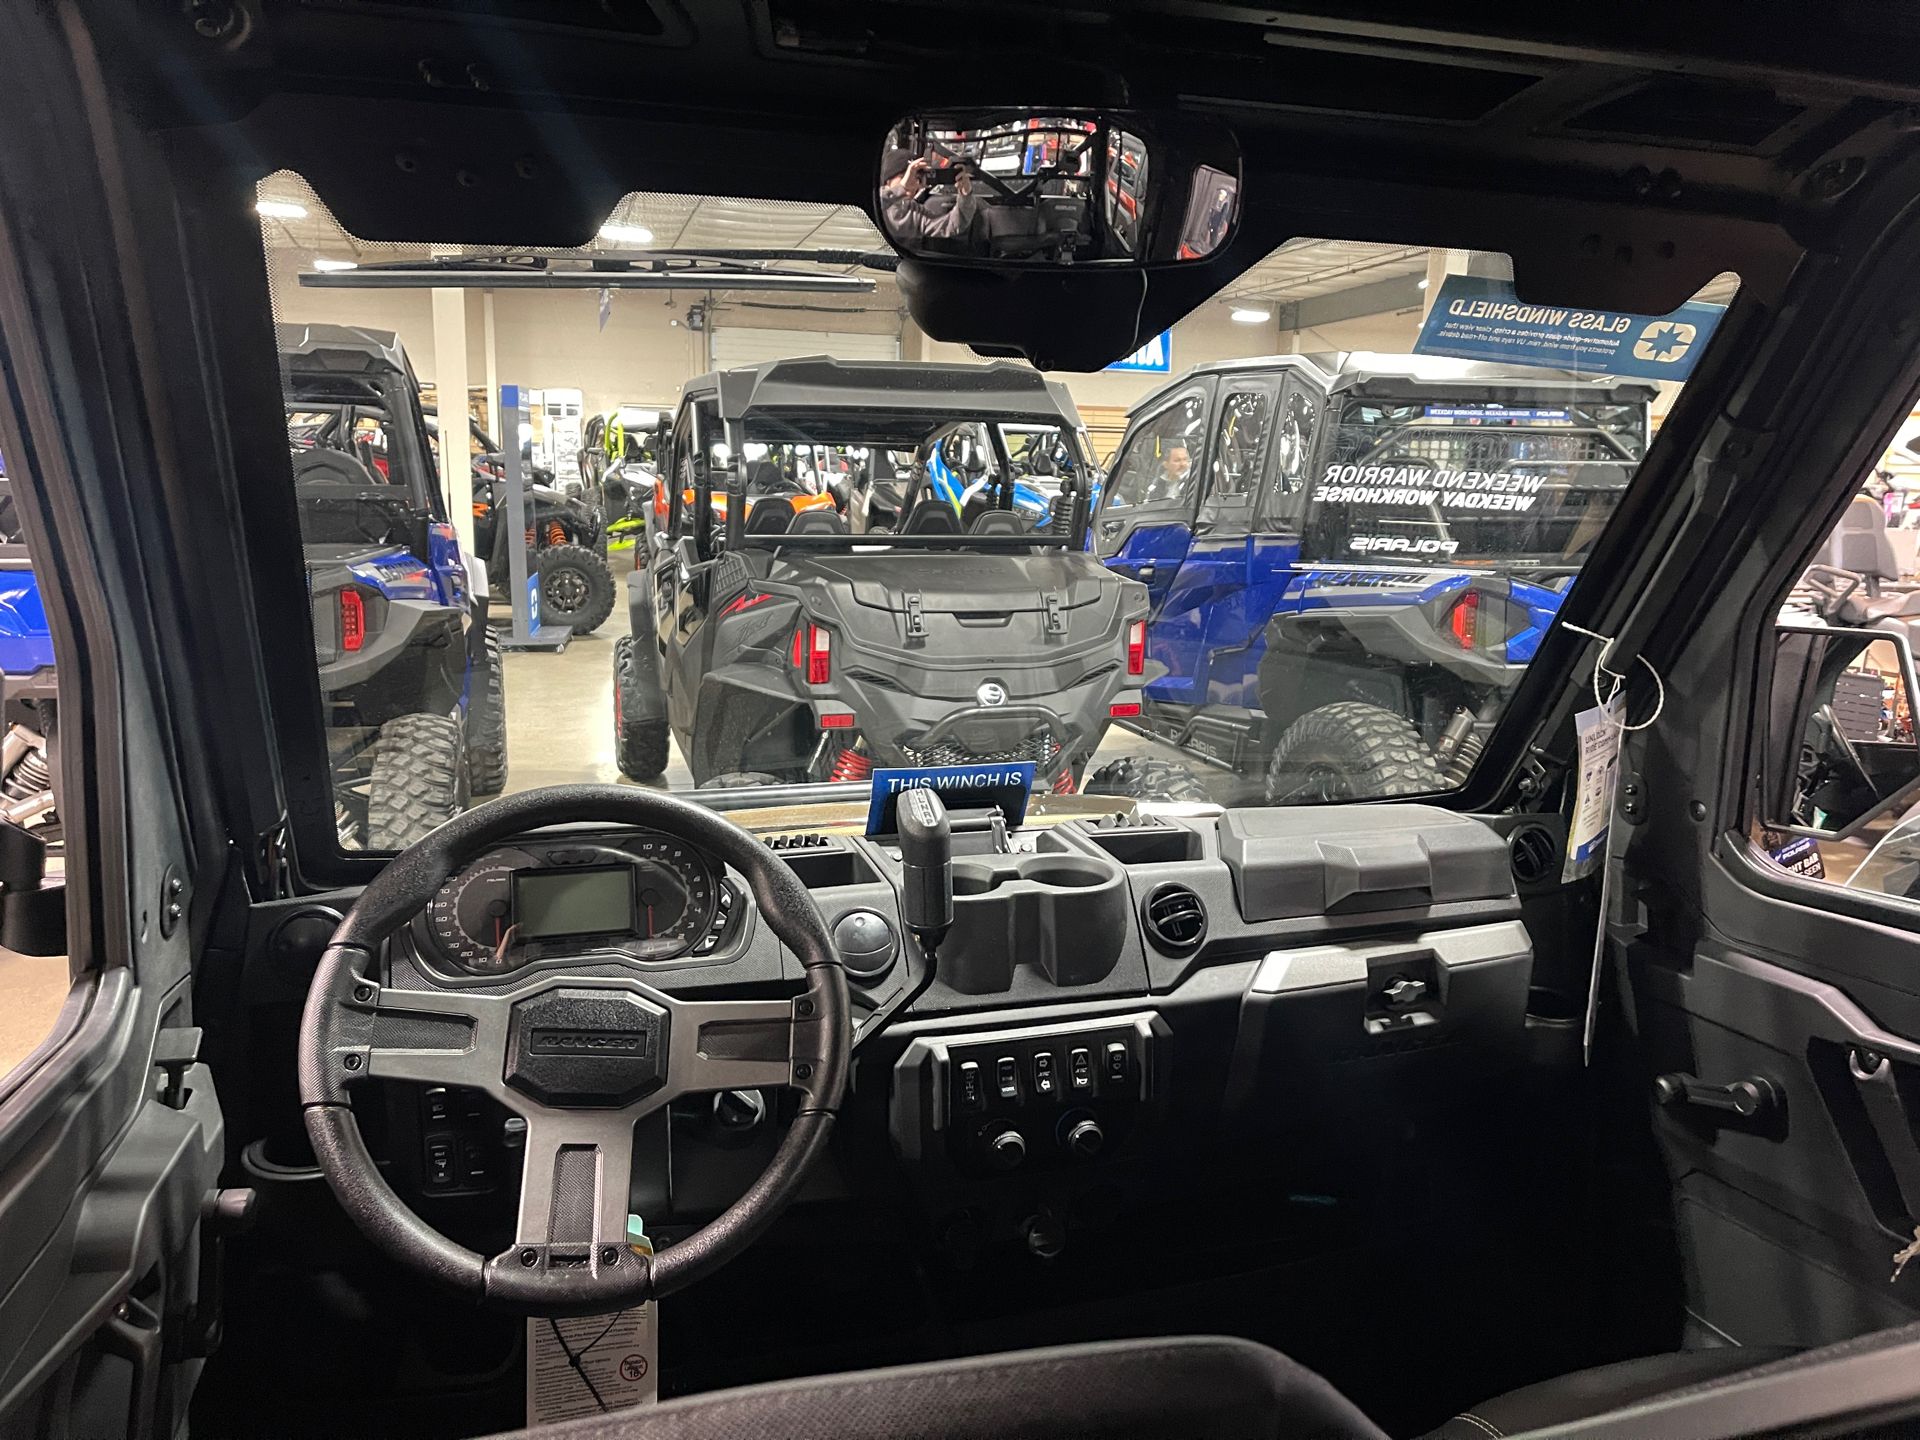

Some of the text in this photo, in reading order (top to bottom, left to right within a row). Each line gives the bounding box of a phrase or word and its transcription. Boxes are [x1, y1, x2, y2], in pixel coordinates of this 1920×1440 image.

[1170, 728, 1217, 757] PARIS
[888, 771, 1022, 793] THIS WINCH IS
